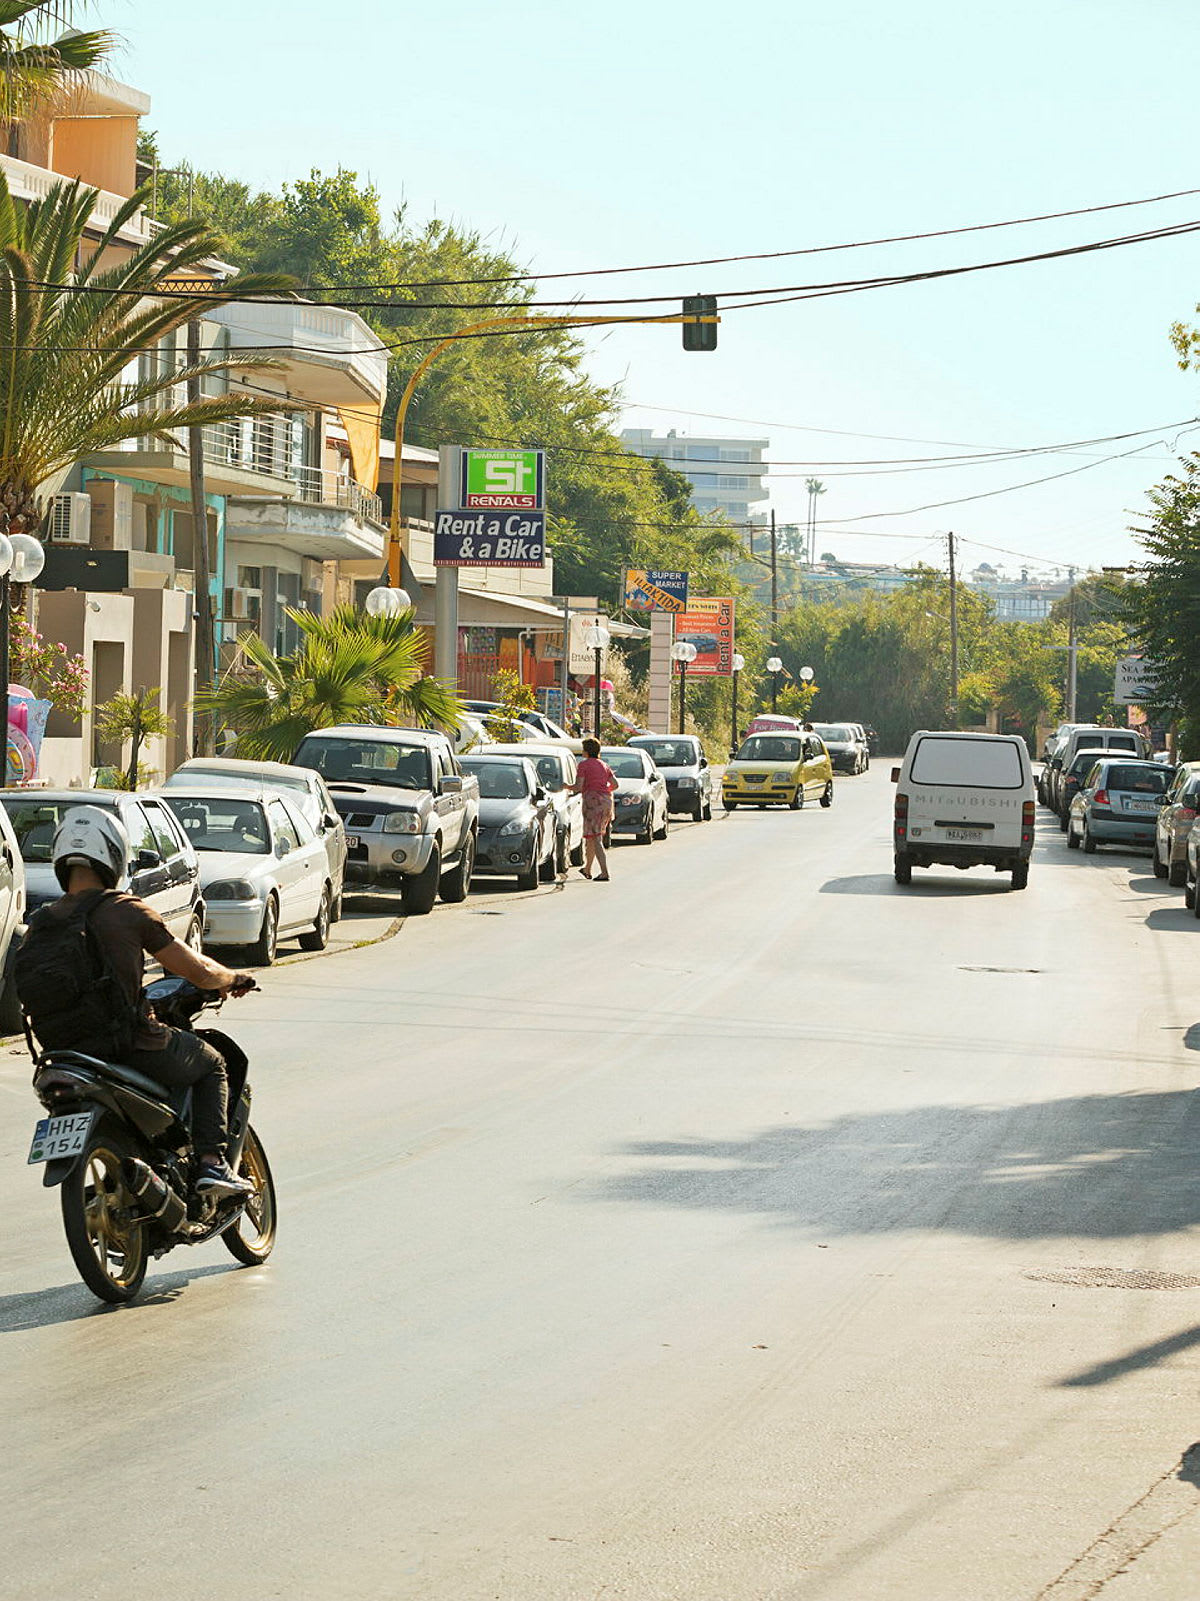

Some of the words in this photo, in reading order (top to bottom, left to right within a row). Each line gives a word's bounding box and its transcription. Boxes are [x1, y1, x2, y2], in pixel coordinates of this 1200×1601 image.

[470, 496, 533, 507] RENTALS
[437, 514, 485, 535] Rent
[487, 520, 500, 535] a
[505, 515, 542, 536] Car
[459, 537, 475, 559] &
[478, 543, 492, 559] a
[495, 538, 542, 559] Bike
[651, 571, 682, 580] SUPER
[655, 581, 686, 589] MARKET
[718, 602, 731, 627] Car
[719, 629, 730, 638] a
[716, 641, 731, 673] Rent
[47, 1137, 81, 1154] 154
